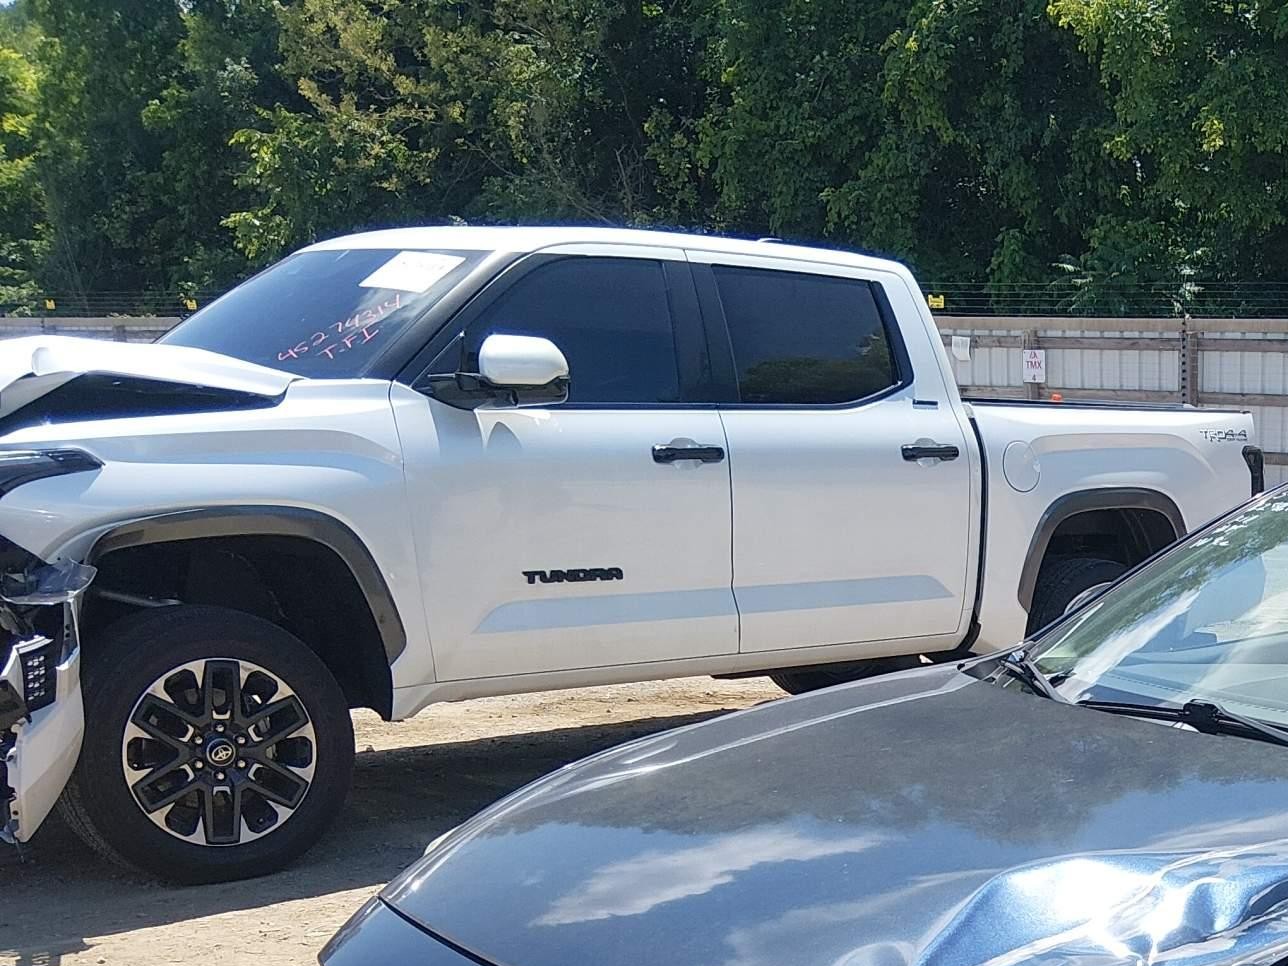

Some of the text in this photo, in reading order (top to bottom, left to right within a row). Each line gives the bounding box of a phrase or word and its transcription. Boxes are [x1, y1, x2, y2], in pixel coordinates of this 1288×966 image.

[1025, 360, 1042, 369] TMX
[1031, 373, 1037, 381] 4
[522, 567, 624, 584] TUNDRA
